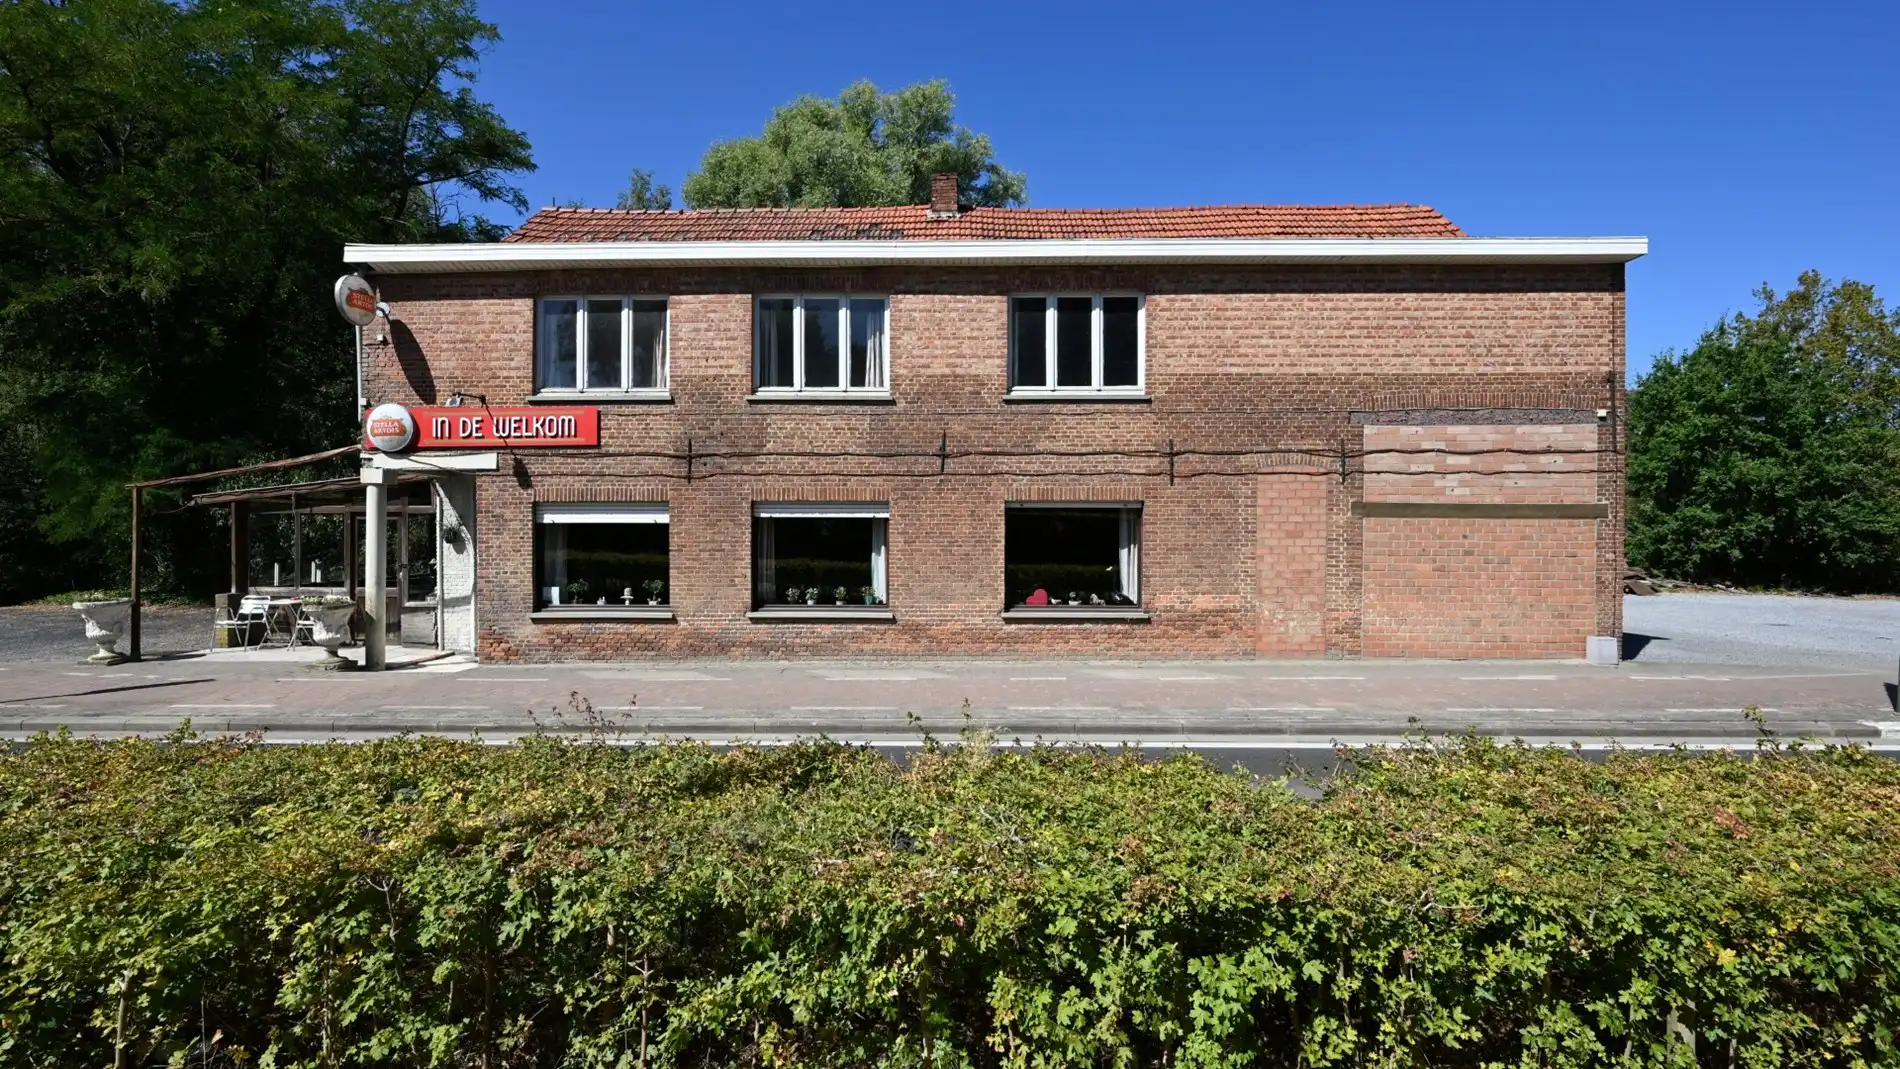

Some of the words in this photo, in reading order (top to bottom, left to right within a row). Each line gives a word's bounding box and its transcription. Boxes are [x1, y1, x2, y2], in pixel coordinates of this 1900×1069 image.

[432, 416, 449, 438] IN
[459, 416, 482, 437] DE
[493, 415, 575, 437] WELKOM
